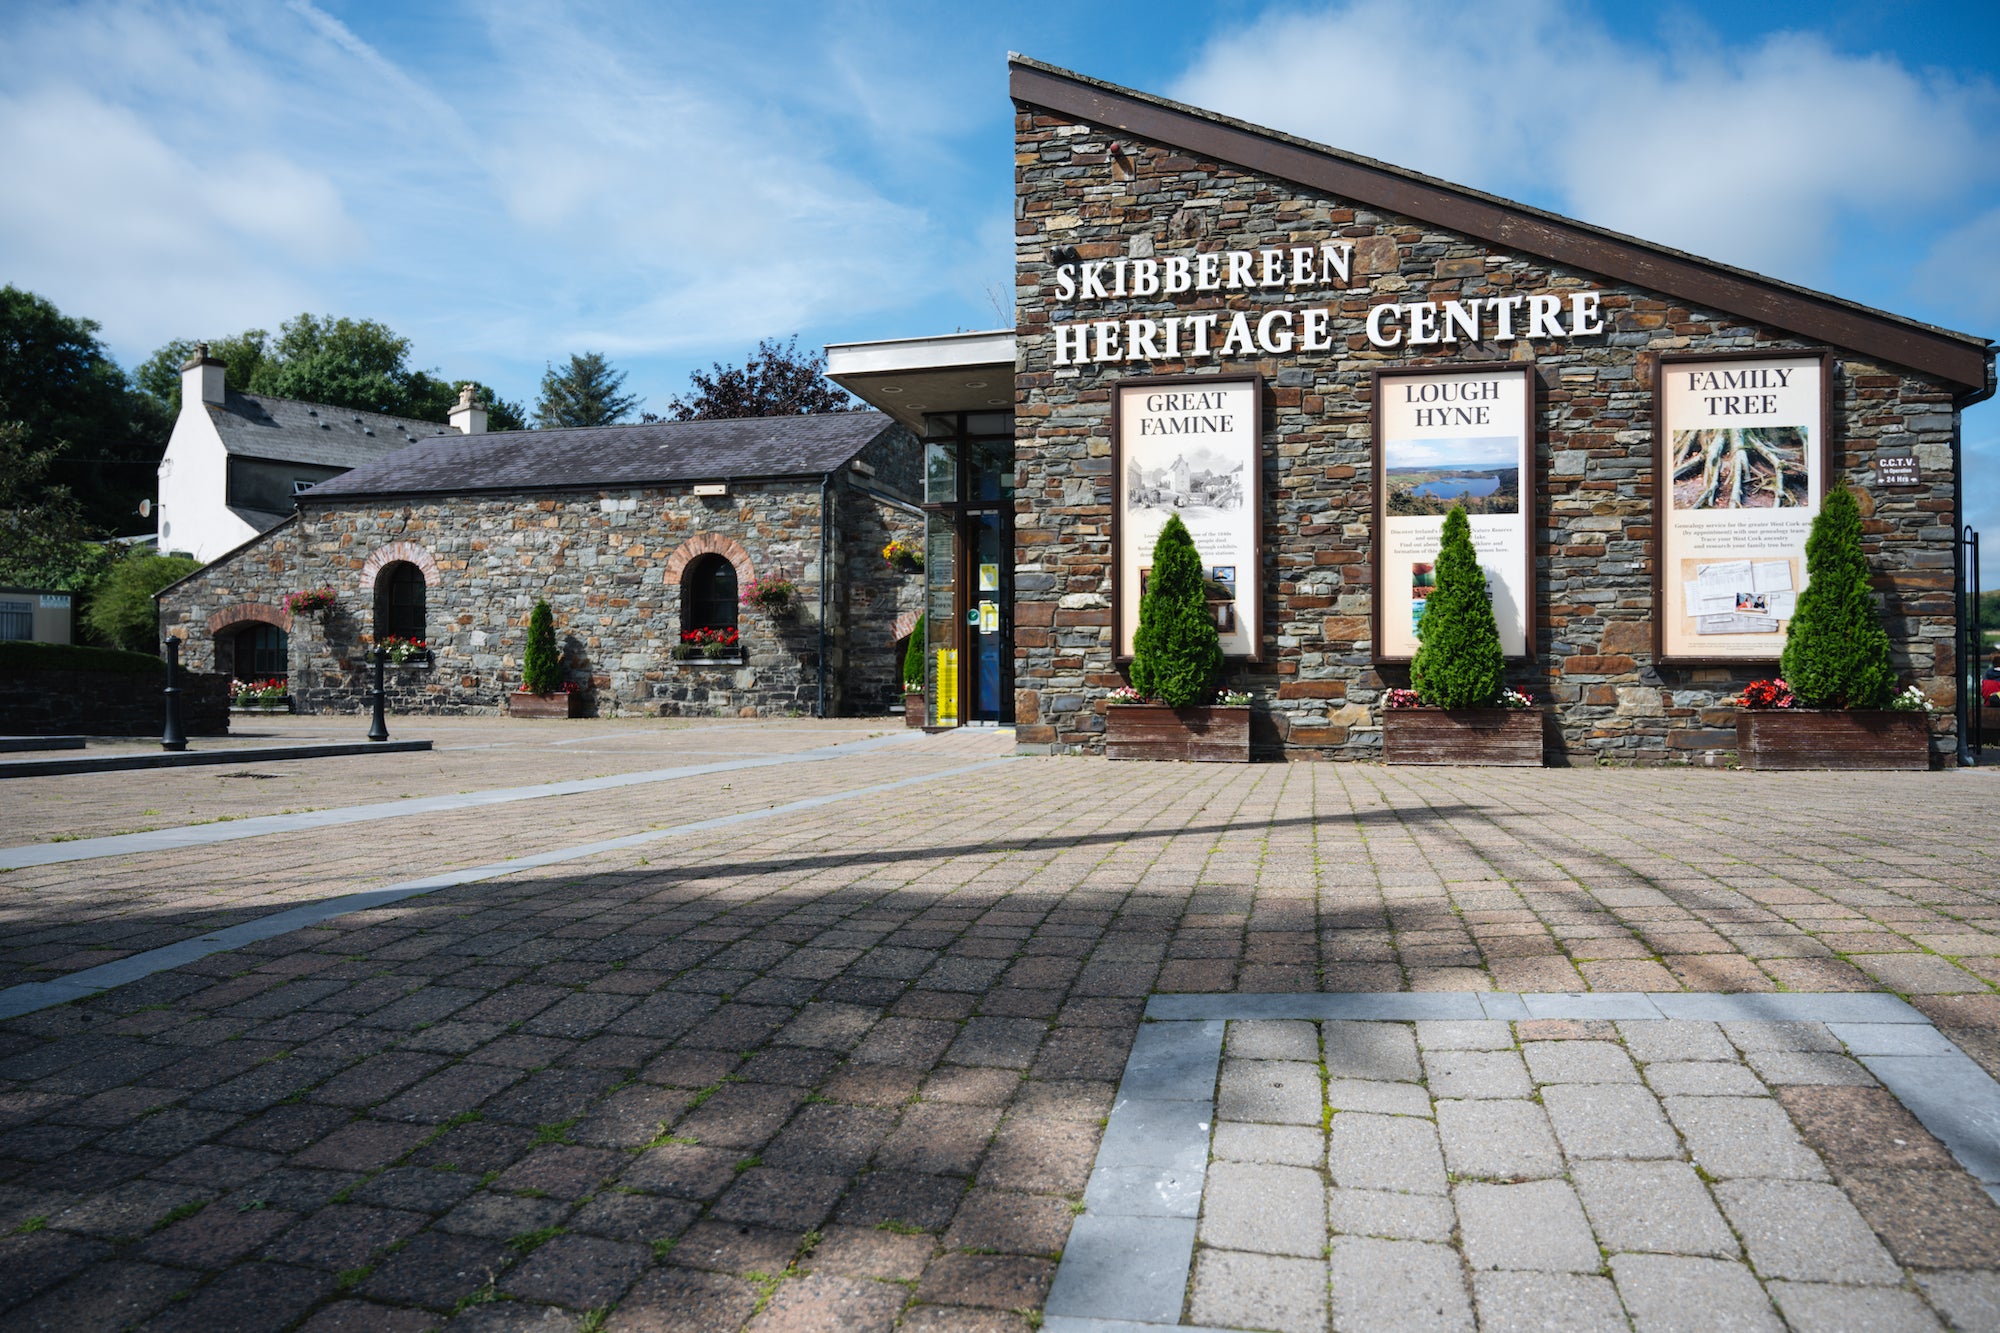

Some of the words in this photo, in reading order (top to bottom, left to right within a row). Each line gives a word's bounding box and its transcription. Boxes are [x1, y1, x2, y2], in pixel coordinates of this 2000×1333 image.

[1054, 245, 1353, 301] SKIBBEREEN
[1053, 307, 1333, 367] HERITAGE
[1366, 291, 1604, 349] CENTRE
[1688, 367, 1793, 391] FAMILY
[1146, 391, 1228, 413] GREAT
[1405, 381, 1500, 403] LOUGH
[1704, 394, 1777, 416] TREE
[1140, 414, 1234, 436] FAMINE
[1415, 406, 1490, 427] HYNE
[1879, 458, 1916, 467] C.C.T.V.
[1896, 475, 1909, 483] Hrs
